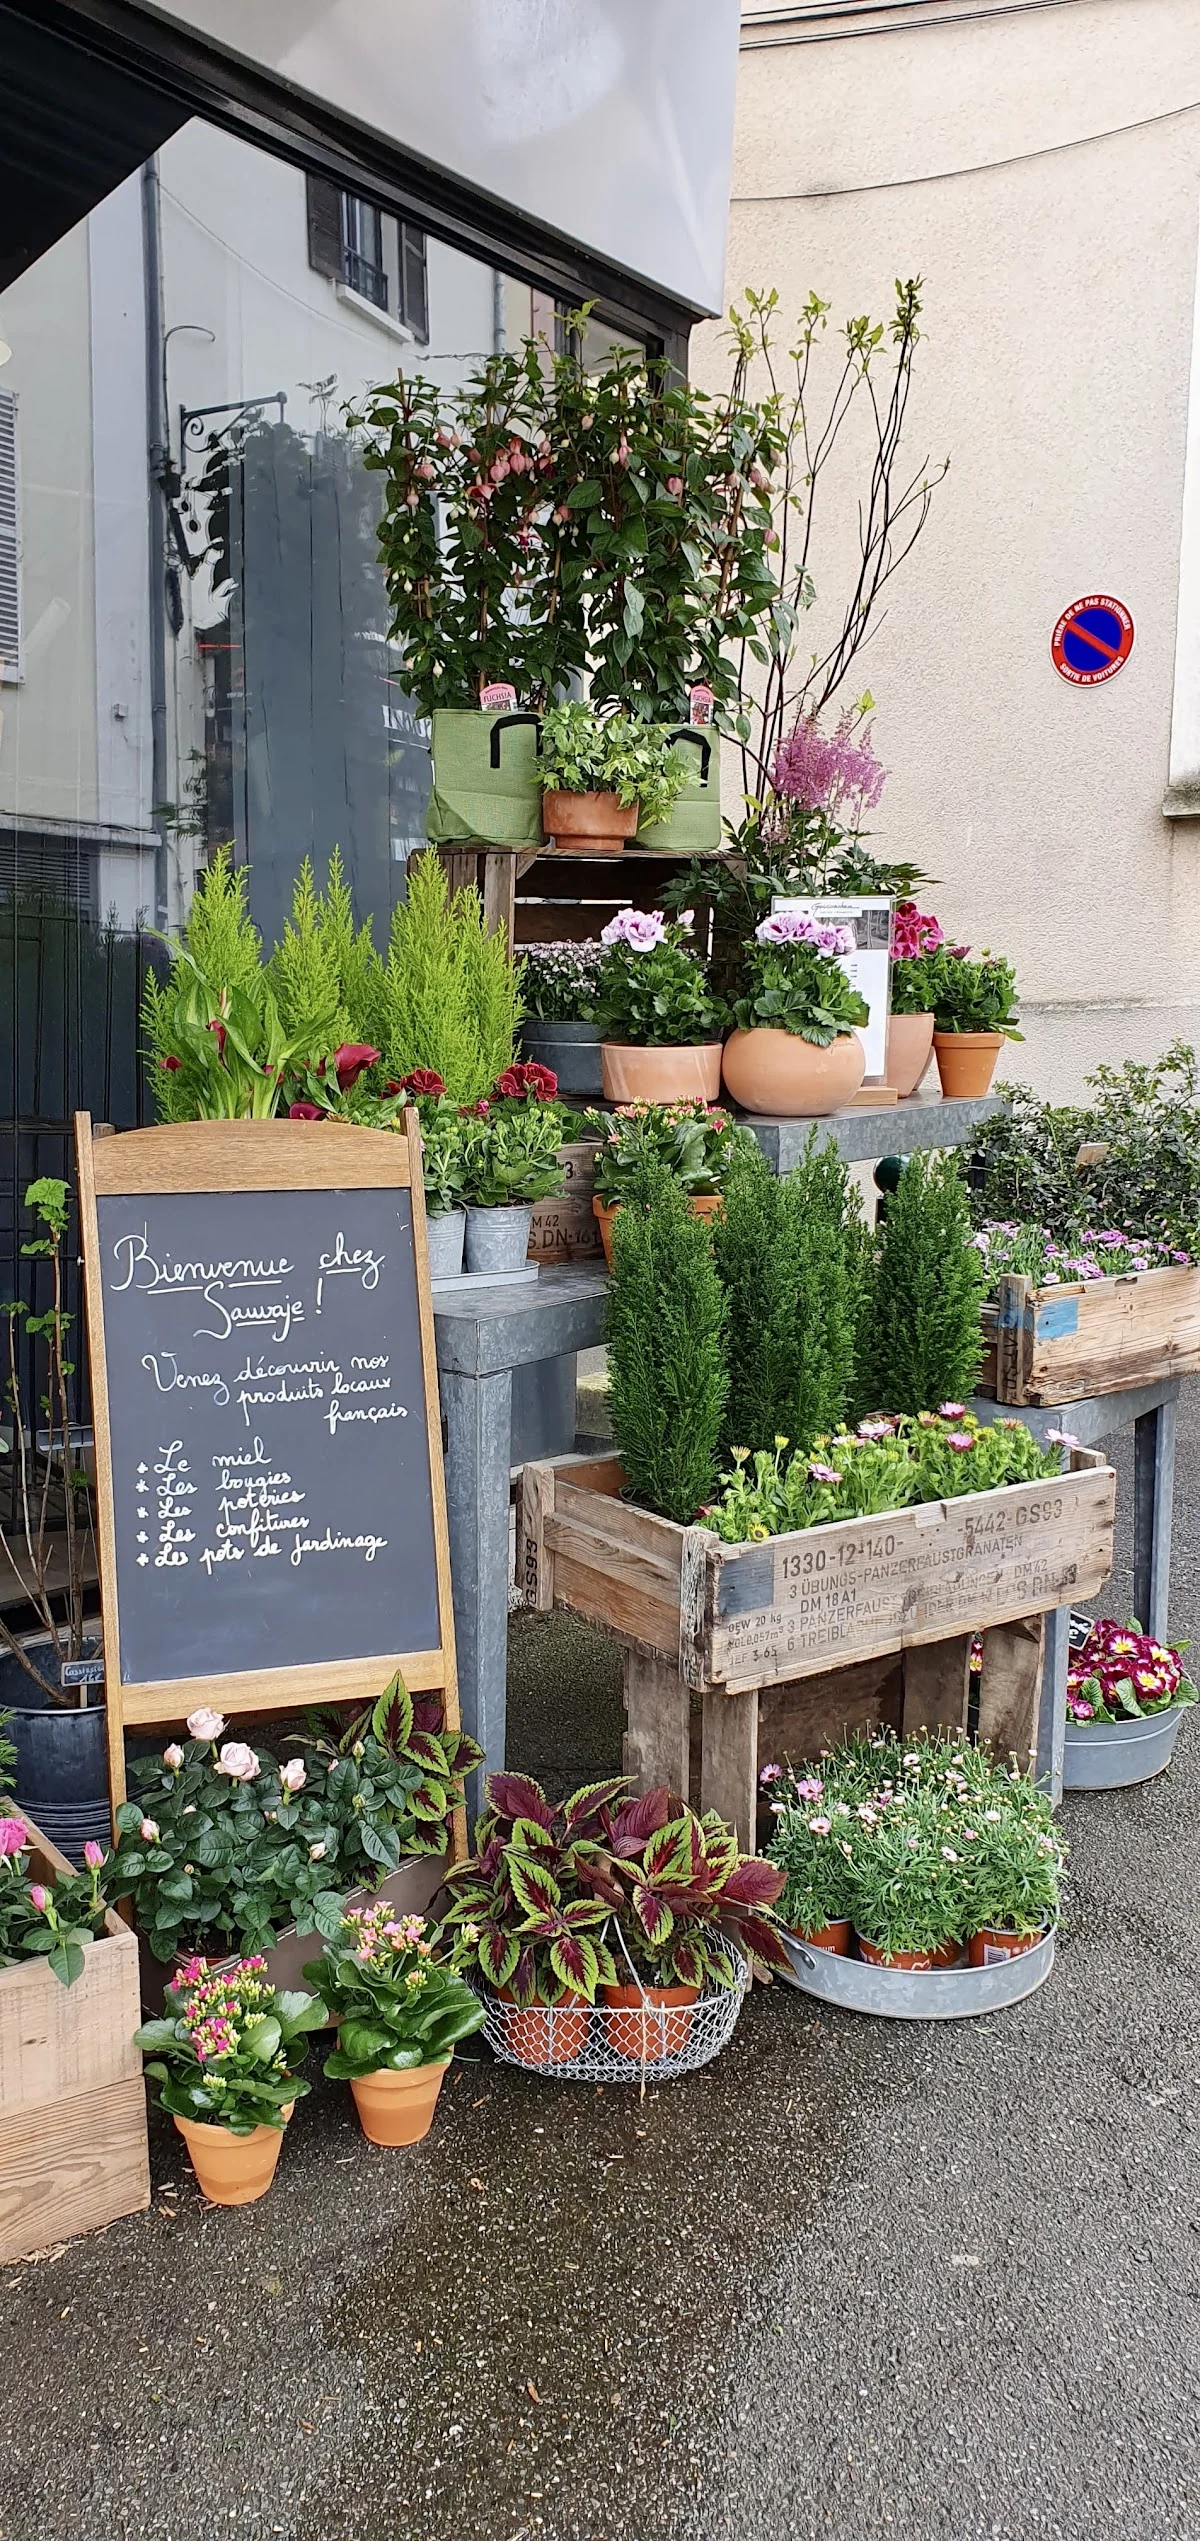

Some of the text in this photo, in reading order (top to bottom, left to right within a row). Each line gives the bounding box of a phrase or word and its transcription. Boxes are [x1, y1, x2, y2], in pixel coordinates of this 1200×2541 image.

[1064, 609, 1075, 620] DE
[1074, 602, 1084, 612] NE
[1084, 598, 1100, 606] PAS
[1100, 597, 1132, 631] STATIONNER
[1060, 655, 1124, 683] SORTIE DE VOITURES
[483, 691, 512, 703] FUCHSIA
[110, 1231, 386, 1292] Bienvenue chez
[193, 1281, 304, 1342] Sauvaje
[141, 1351, 391, 1406] Venez découvrir nos
[237, 1372, 392, 1427] produits locaux
[324, 1400, 409, 1435] français
[153, 1436, 272, 1473] Le miel
[156, 1470, 292, 1497] Les bougies
[157, 1489, 306, 1527] Les poteries
[158, 1509, 310, 1548] Les confitures
[154, 1543, 189, 1567] Les
[199, 1539, 245, 1575] pots
[253, 1535, 283, 1558] de
[525, 1538, 538, 1605] GS93
[789, 1584, 798, 1599] 3
[800, 1595, 821, 1614] DM
[755, 1615, 766, 1628] 20
[770, 1613, 782, 1625] kg
[787, 1636, 795, 1652] 6
